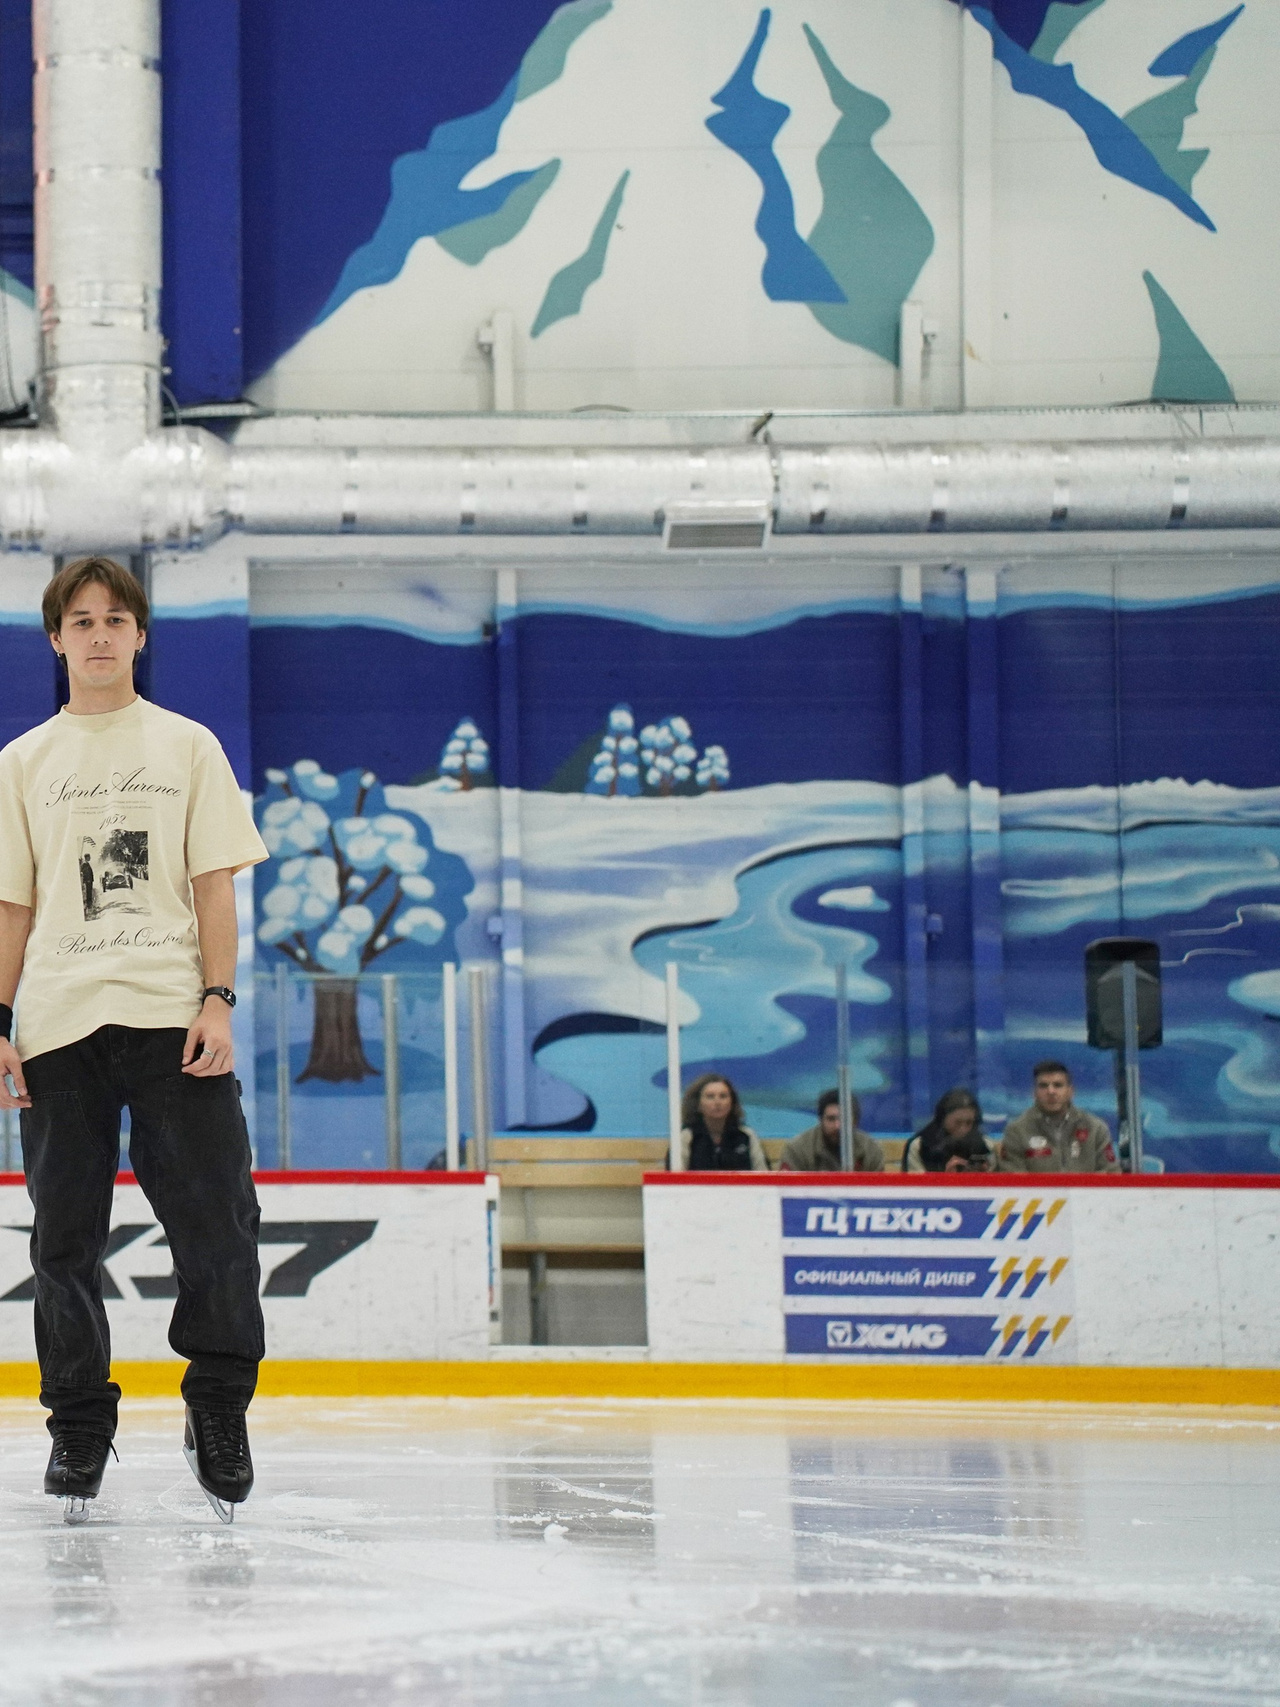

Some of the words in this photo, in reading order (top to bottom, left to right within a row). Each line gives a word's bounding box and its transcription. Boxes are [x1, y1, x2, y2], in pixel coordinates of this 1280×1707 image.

[56, 932, 106, 956] Route
[110, 930, 130, 947] des
[805, 1207, 849, 1235] ГЦ
[854, 1207, 963, 1233] ТЕХНО
[793, 1267, 922, 1287] ОФИЦИАЛЬНЫЙ
[922, 1270, 977, 1289] ДИЛЕР
[854, 1323, 948, 1349] XCMG
